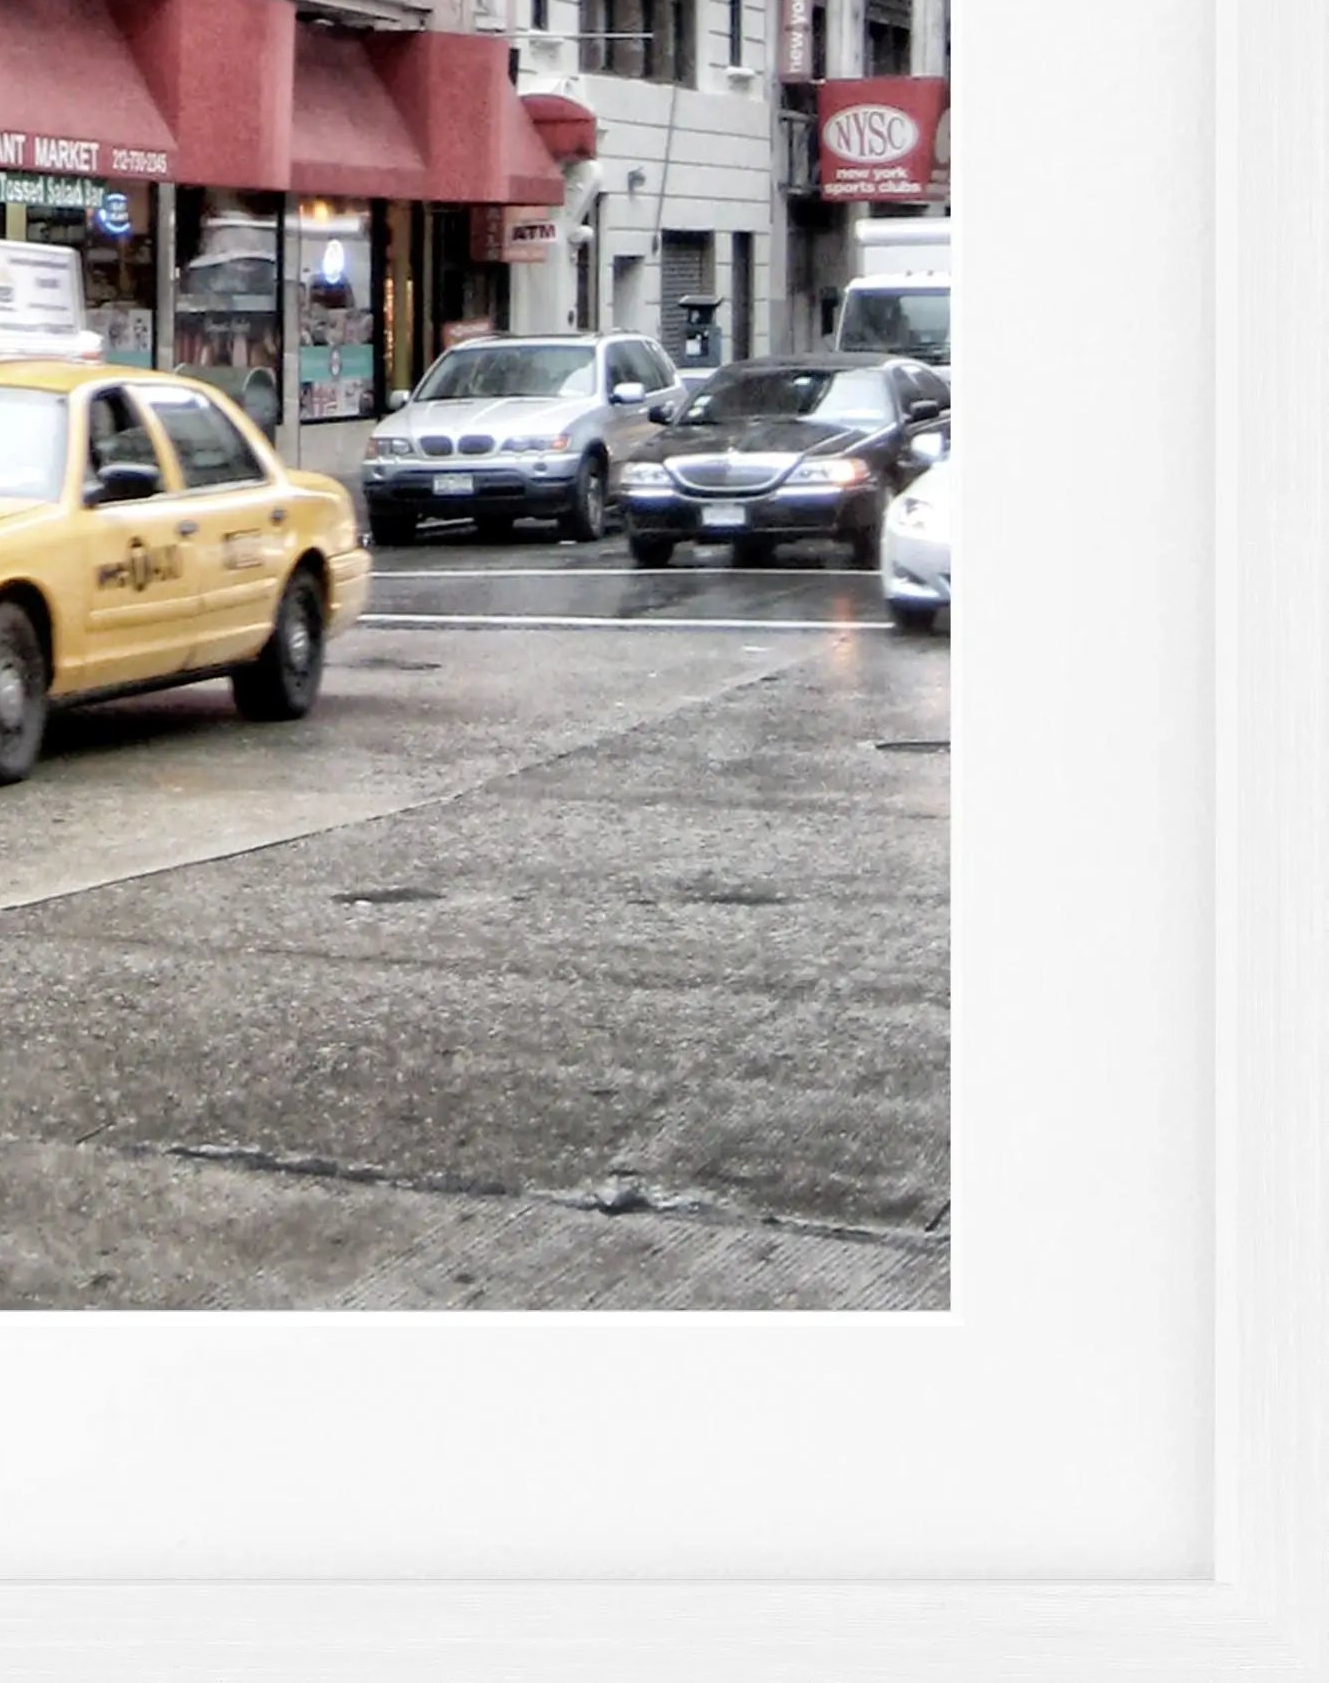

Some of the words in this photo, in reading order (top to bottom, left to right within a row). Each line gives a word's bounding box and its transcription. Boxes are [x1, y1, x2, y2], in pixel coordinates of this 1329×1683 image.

[835, 111, 905, 156] NYSC
[34, 136, 100, 171] MARKET
[835, 168, 870, 179] new
[873, 166, 908, 181] york
[47, 176, 83, 205] Salad
[824, 180, 876, 196] sports
[512, 224, 556, 240] ATM
